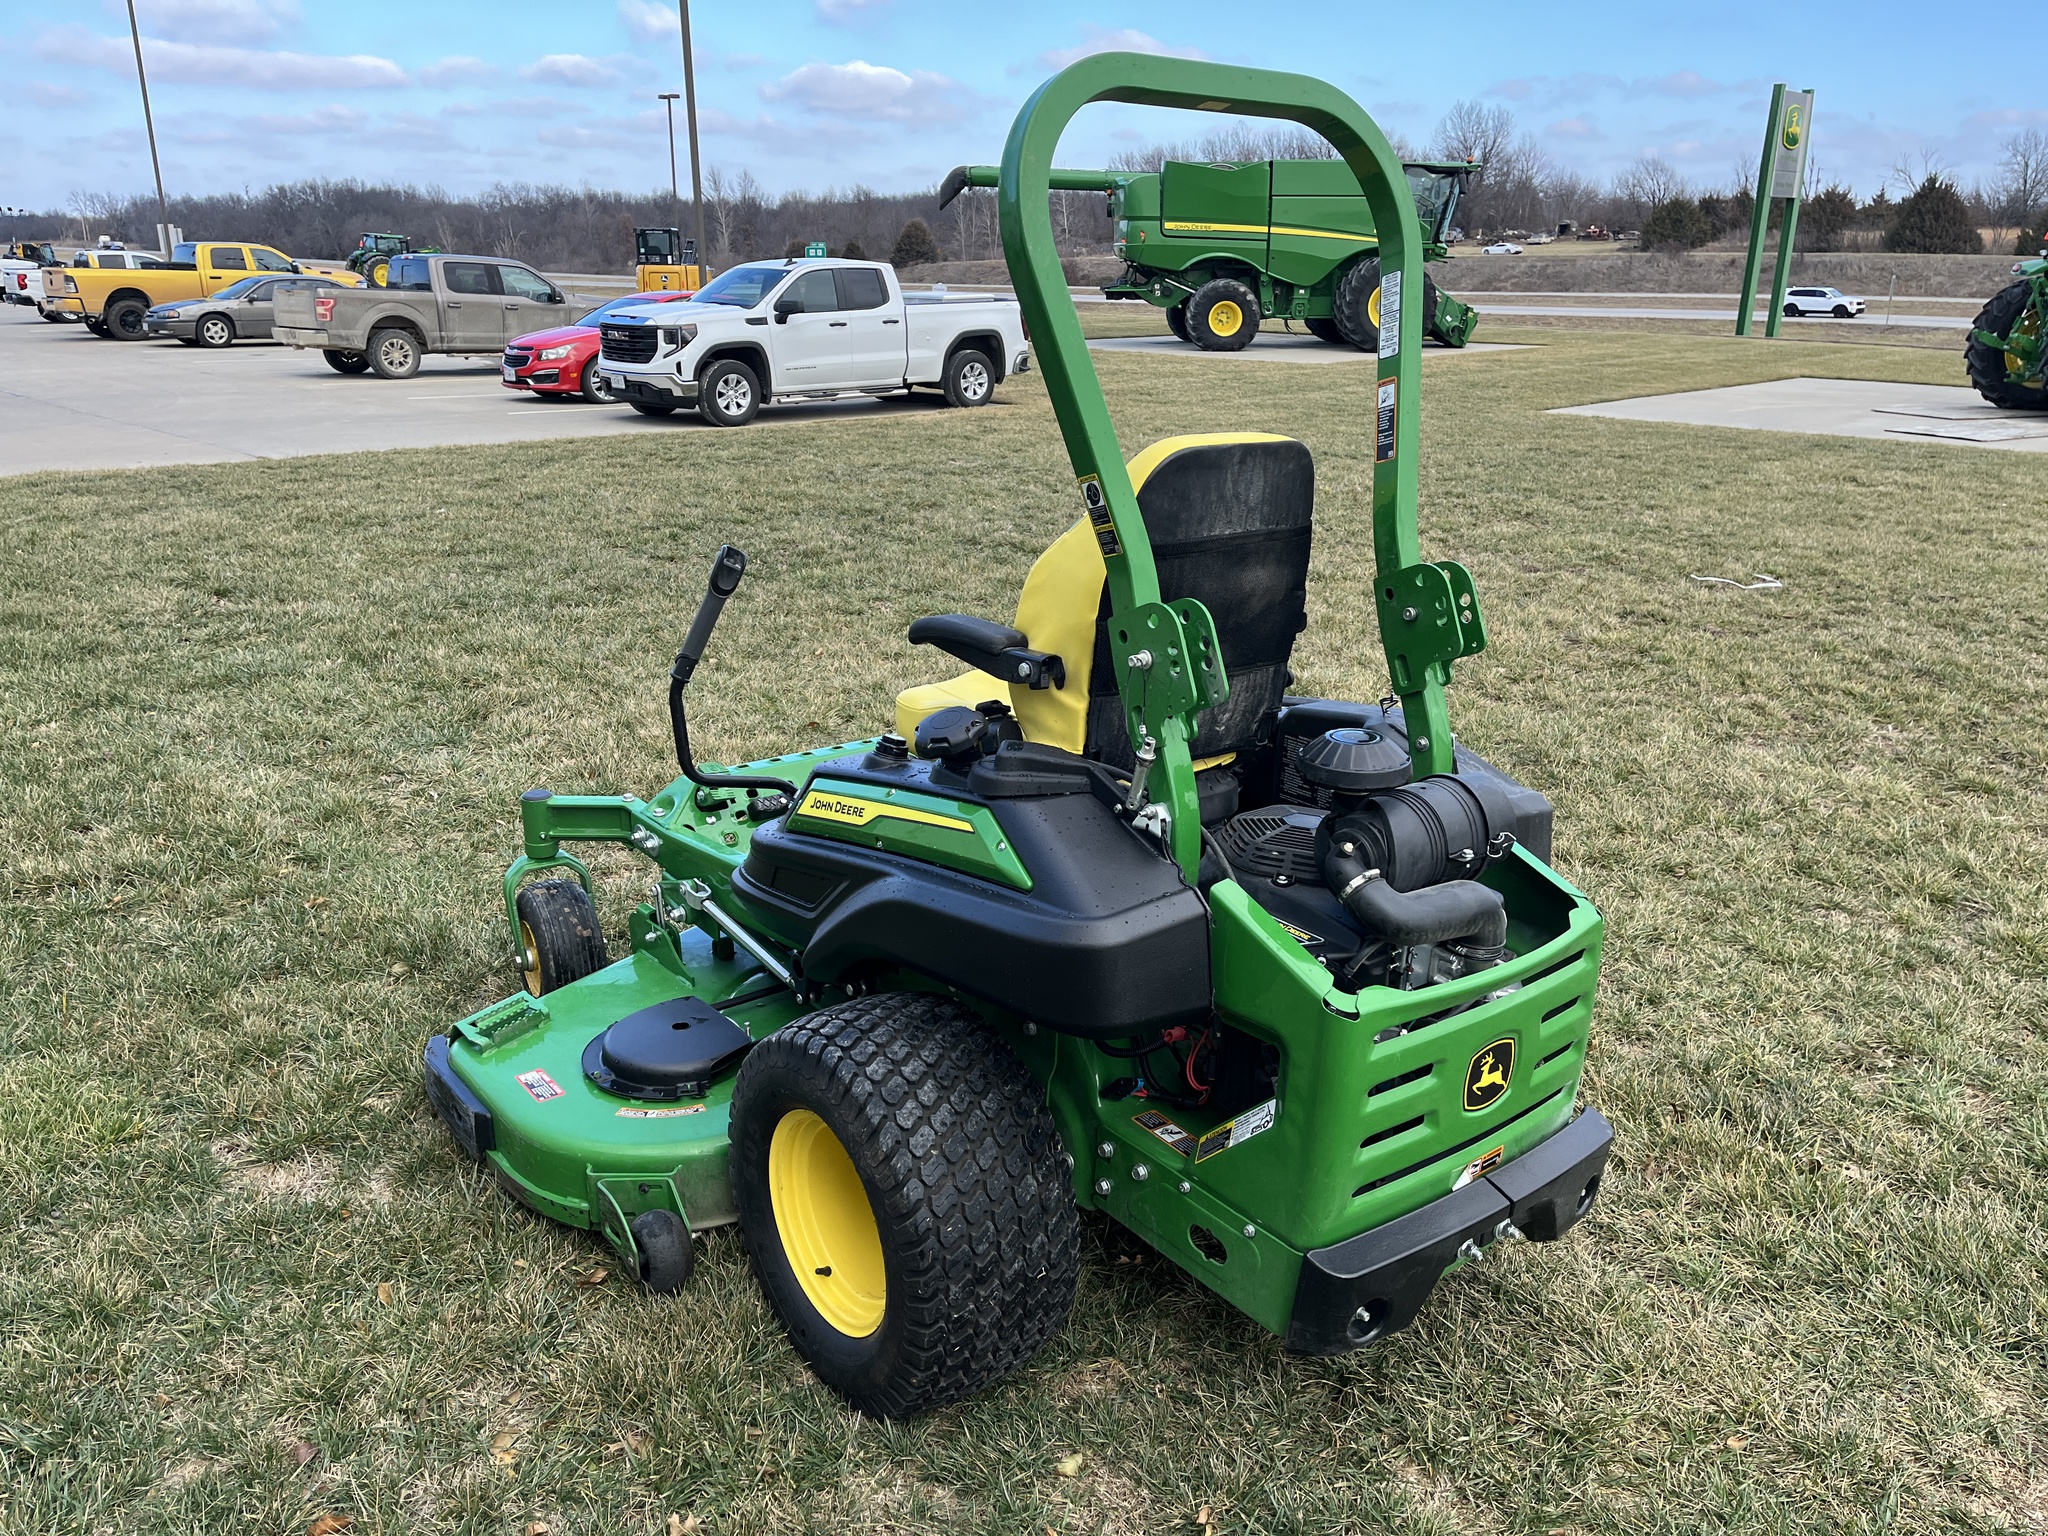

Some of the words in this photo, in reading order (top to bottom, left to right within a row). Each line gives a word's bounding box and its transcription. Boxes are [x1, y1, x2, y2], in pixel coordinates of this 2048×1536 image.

[1173, 223, 1190, 231] JOHN
[1191, 224, 1212, 232] DEERE
[810, 797, 834, 812] JOHN
[834, 801, 865, 818] DEERE
